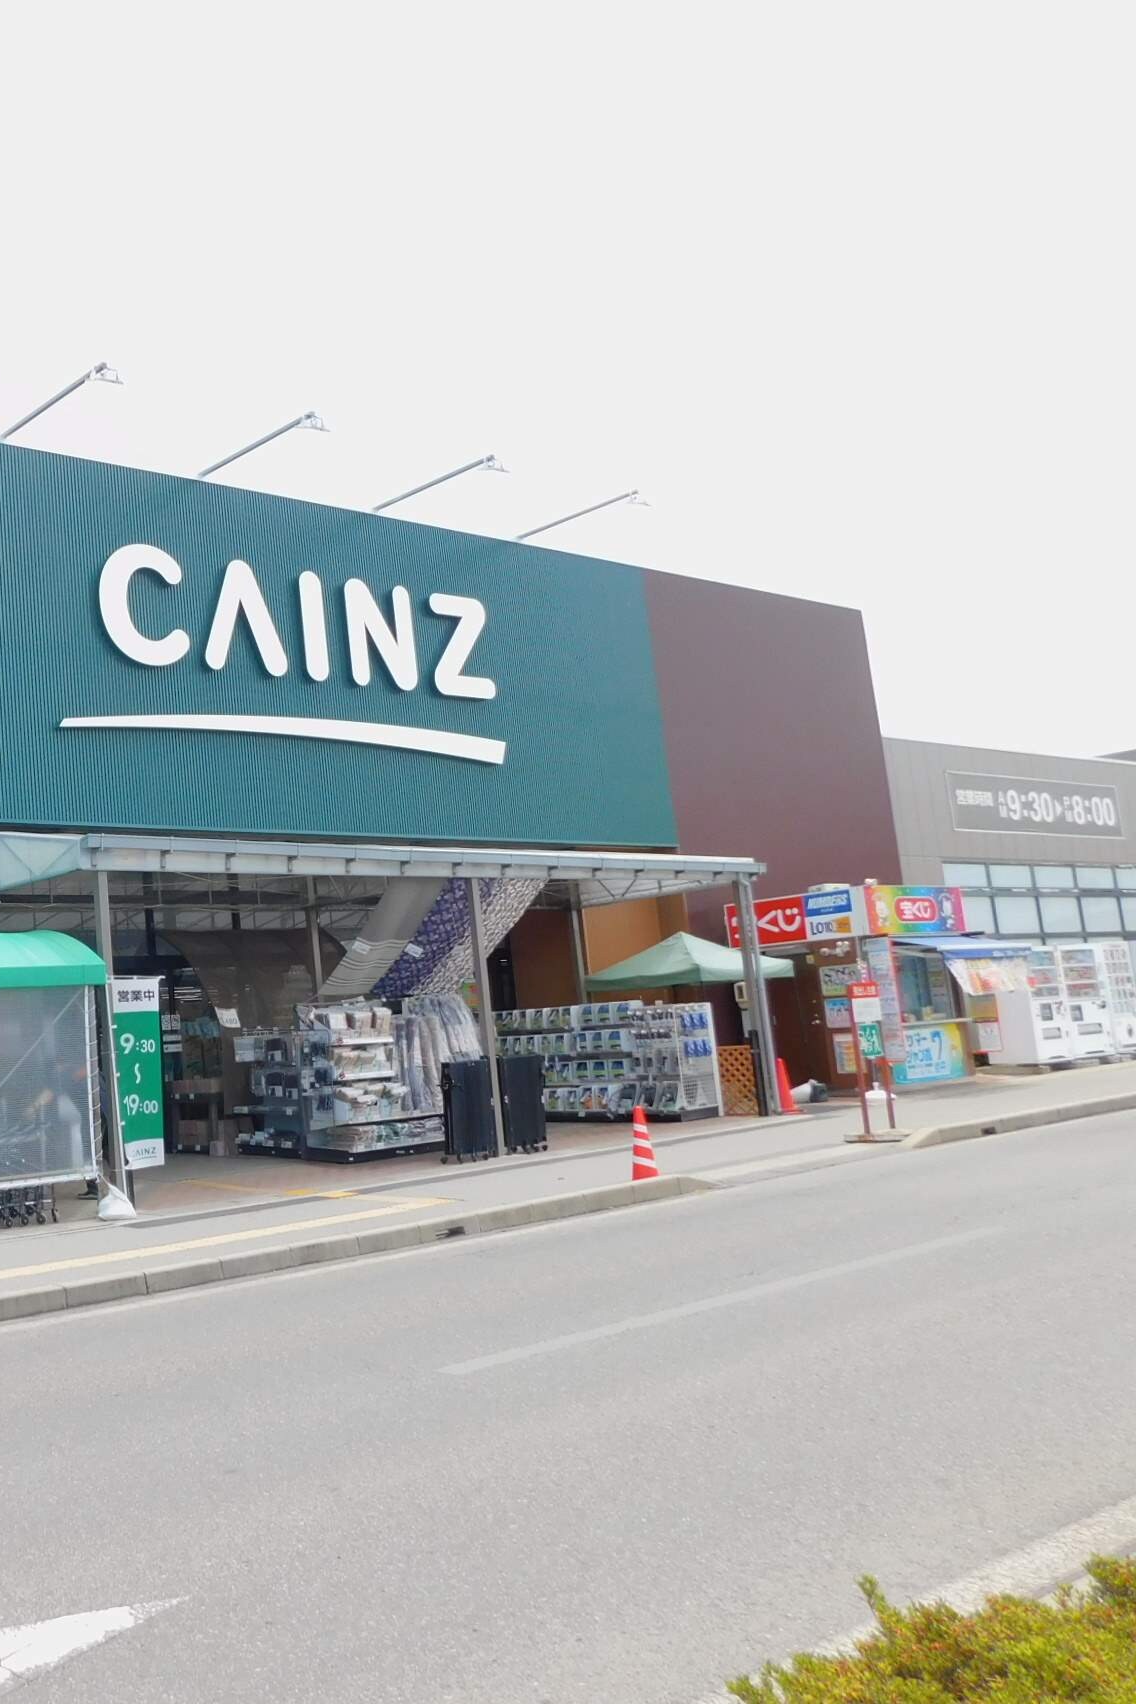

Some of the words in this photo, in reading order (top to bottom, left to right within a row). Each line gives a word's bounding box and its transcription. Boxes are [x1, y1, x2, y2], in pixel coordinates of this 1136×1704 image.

[99, 543, 496, 699] CAINZ
[1006, 789, 1054, 822] 9:30
[1072, 796, 1115, 826] 8:00
[117, 989, 155, 1003] 営業中
[120, 1033, 156, 1055] 9:30
[123, 1094, 159, 1116] 19:00
